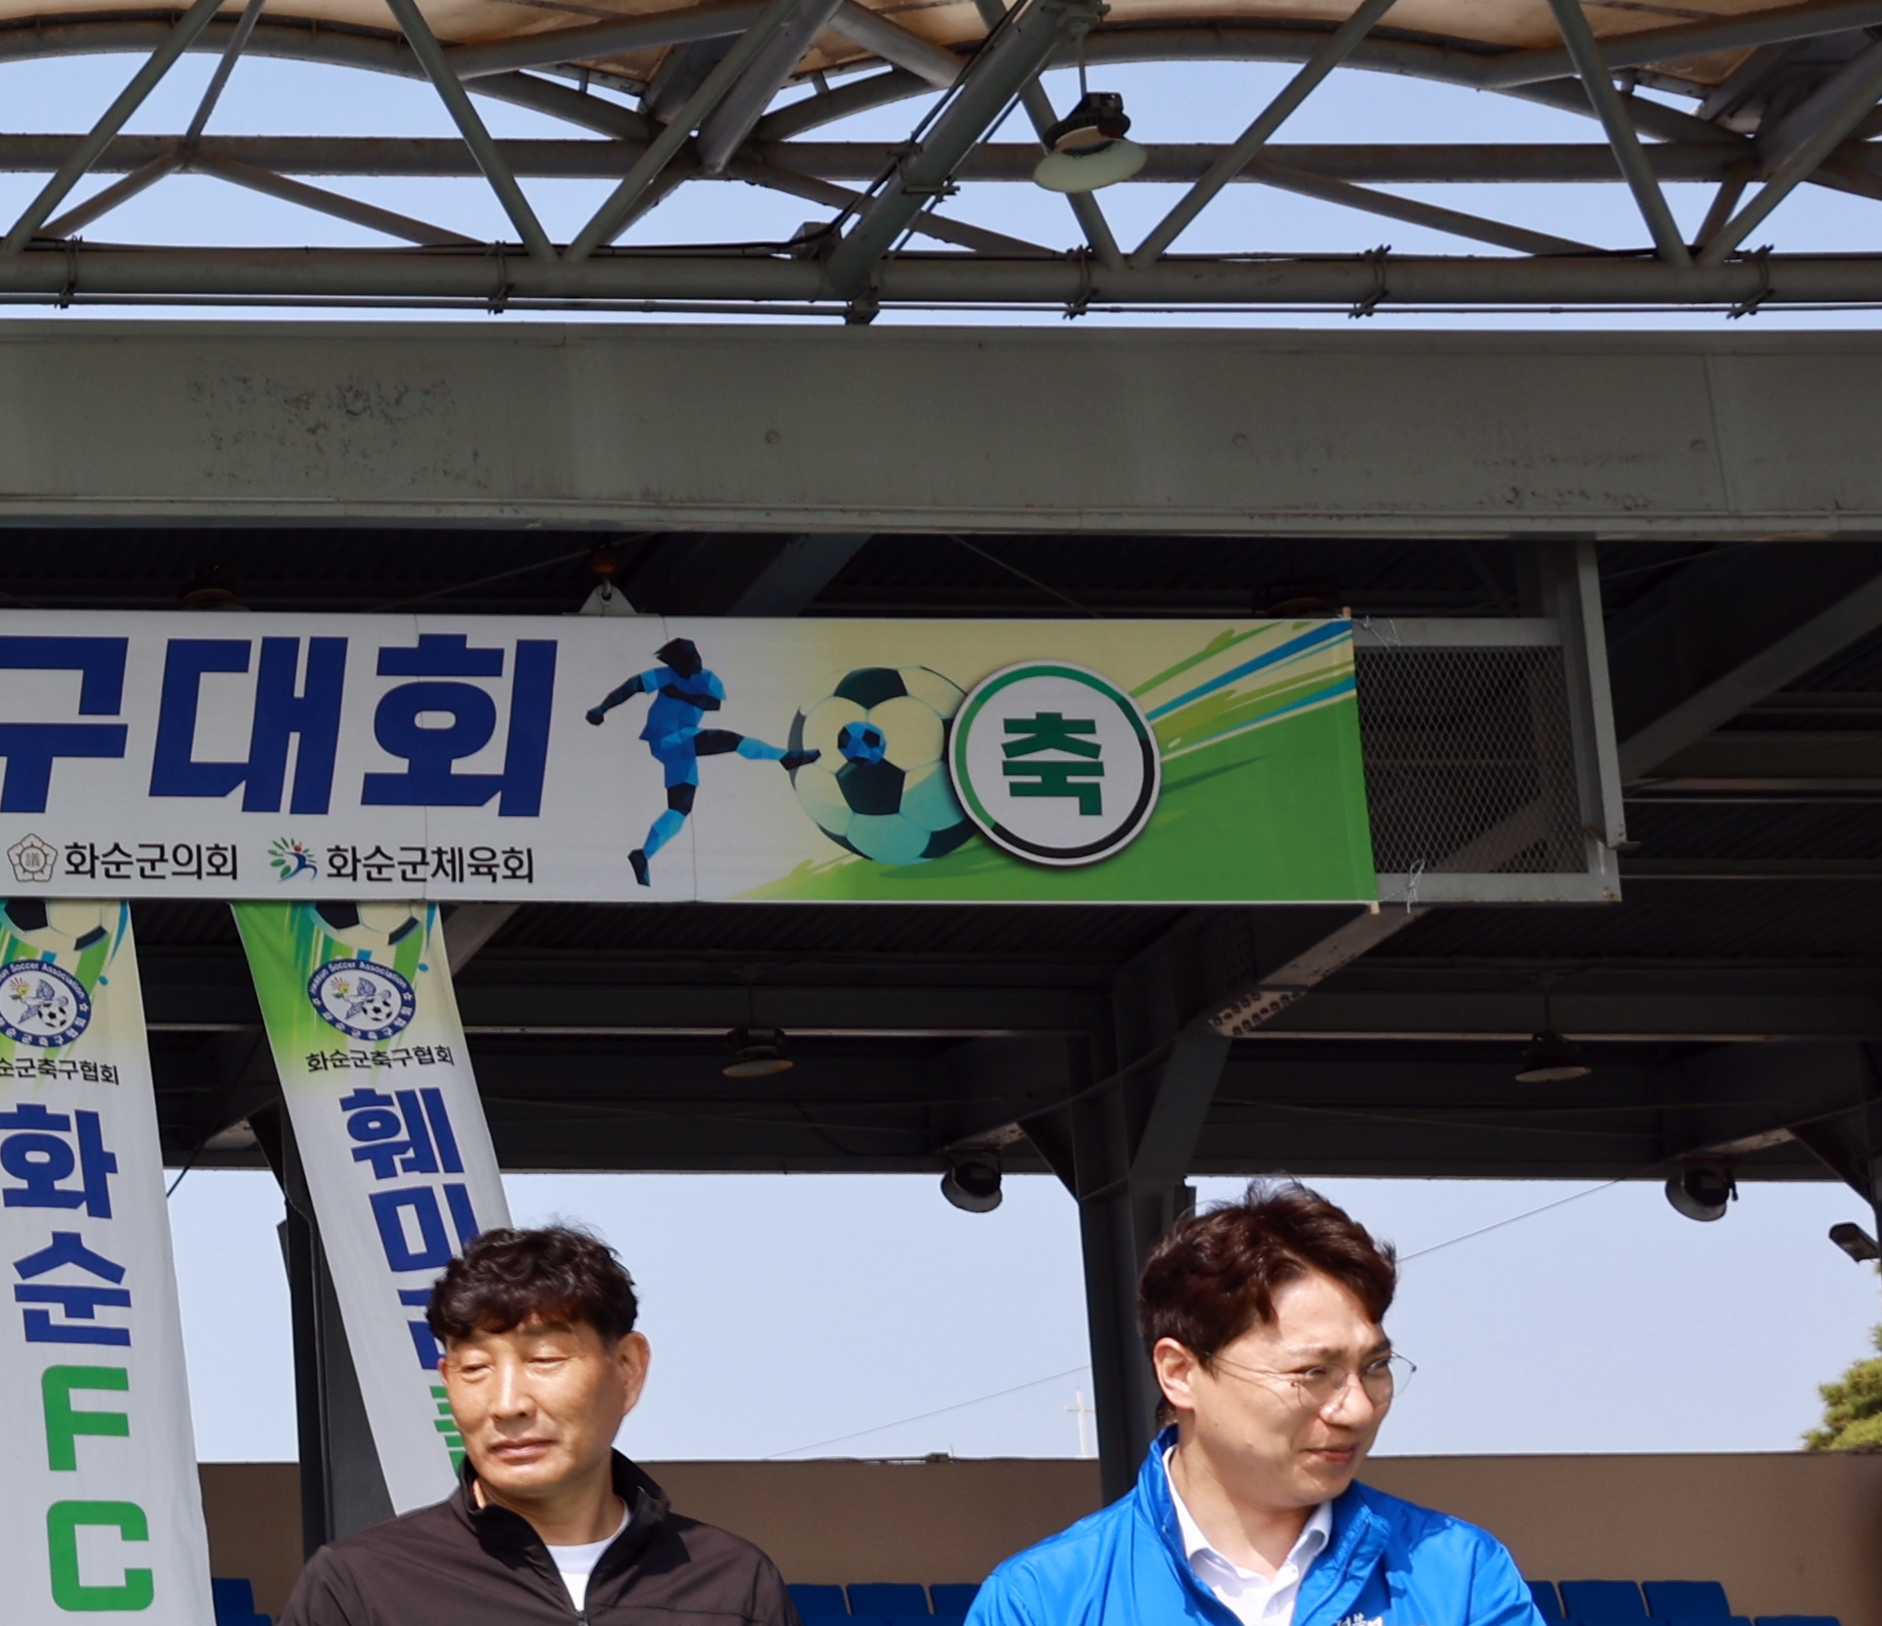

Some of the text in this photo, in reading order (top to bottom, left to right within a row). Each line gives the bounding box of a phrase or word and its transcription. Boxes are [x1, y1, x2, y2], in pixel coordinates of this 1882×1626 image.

[1001, 711, 1103, 817] 축
[64, 840, 239, 883] 화순군의회
[326, 843, 535, 886] 화순군체육회
[305, 1044, 455, 1073] 화순군축구협회
